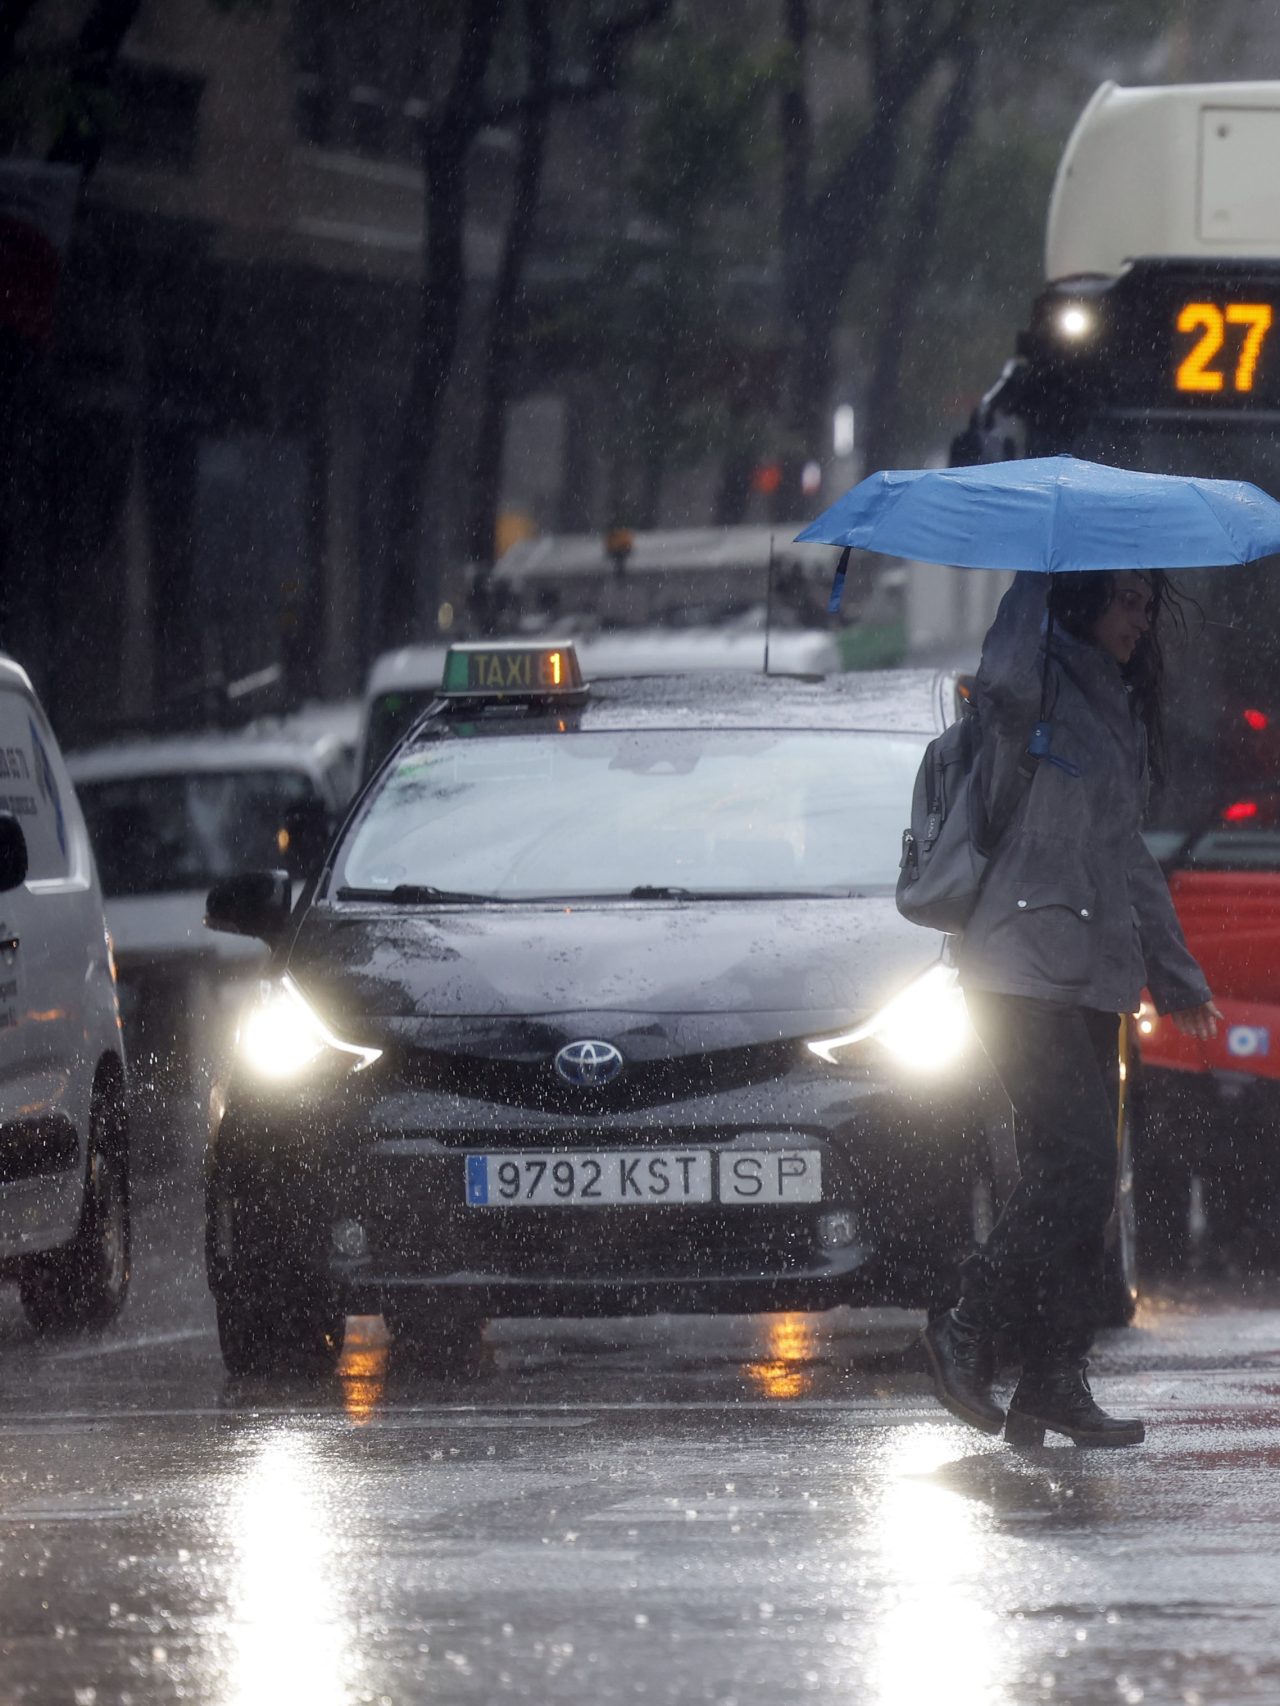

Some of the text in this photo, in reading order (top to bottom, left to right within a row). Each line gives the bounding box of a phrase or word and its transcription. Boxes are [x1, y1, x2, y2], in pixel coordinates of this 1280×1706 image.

[1176, 303, 1272, 391] 27
[474, 652, 560, 687] TAXI 1
[498, 1156, 697, 1199] 9792 KST
[733, 1157, 807, 1196] SP
